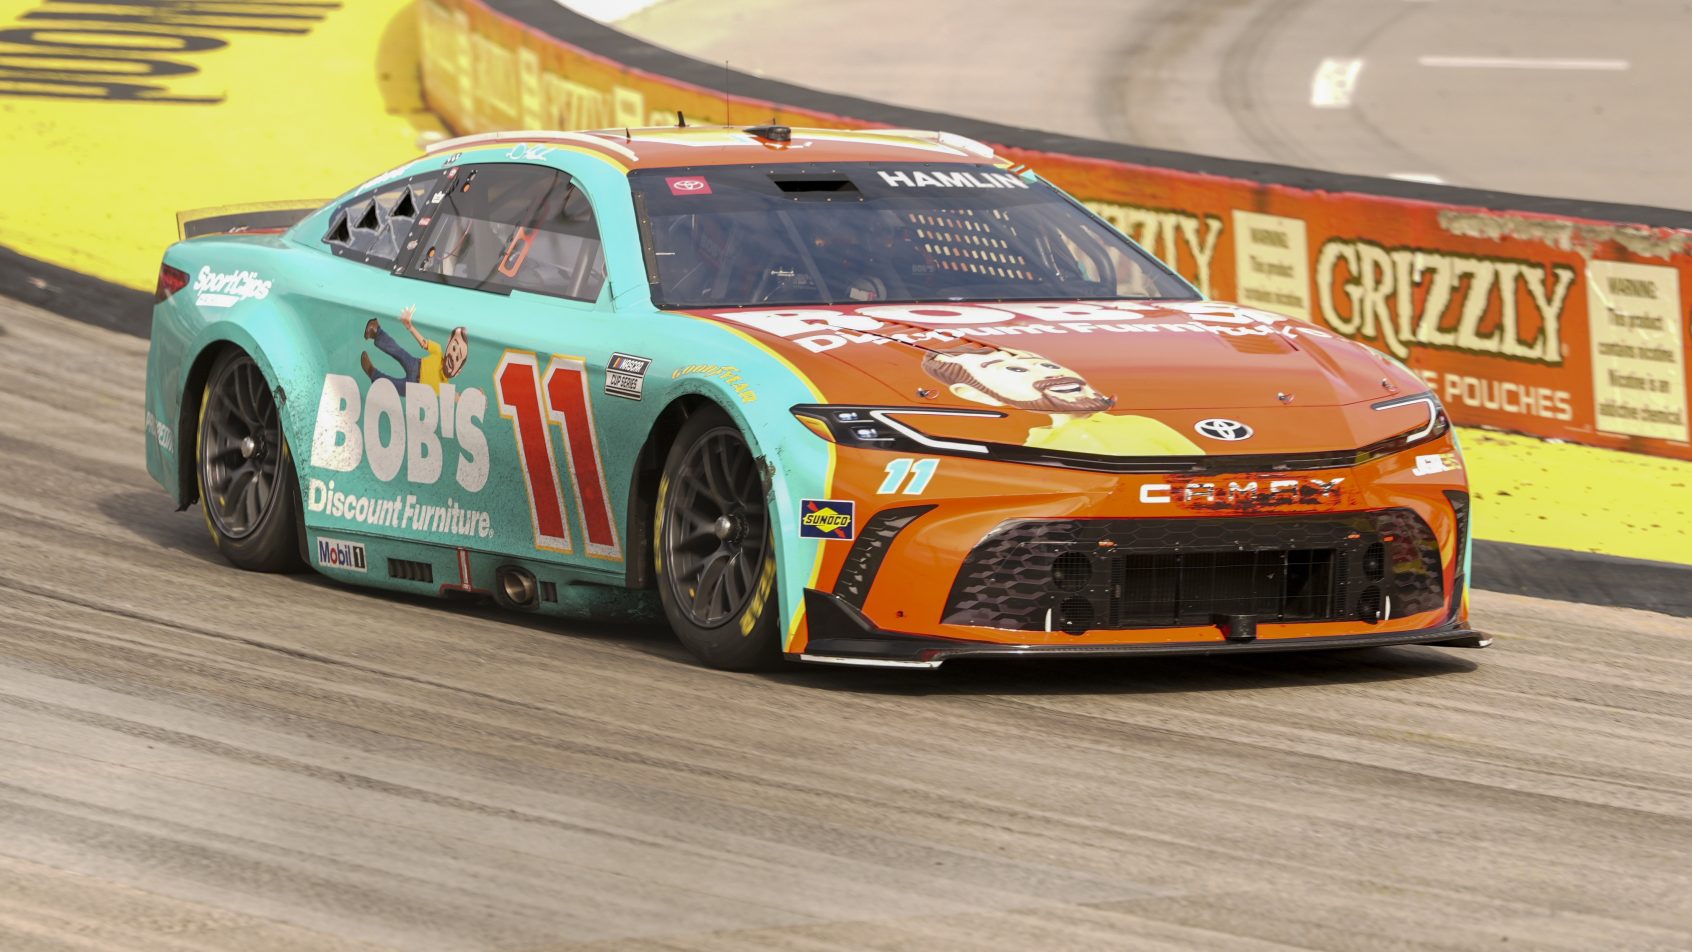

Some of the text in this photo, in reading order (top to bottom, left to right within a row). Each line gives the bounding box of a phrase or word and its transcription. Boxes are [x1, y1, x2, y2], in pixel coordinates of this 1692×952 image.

[877, 170, 1030, 189] HAMLIN
[1315, 235, 1576, 364] GRIZZLY
[714, 301, 1288, 337] BOB'S
[611, 374, 638, 389] CUP SERIES
[1444, 373, 1573, 421] POUCHES
[310, 373, 490, 493] BOB'S
[493, 348, 624, 562] 11
[876, 458, 940, 495] 11
[308, 477, 403, 528] Discount
[805, 514, 849, 526] SUNOCO
[319, 541, 365, 568] Mobil 1
